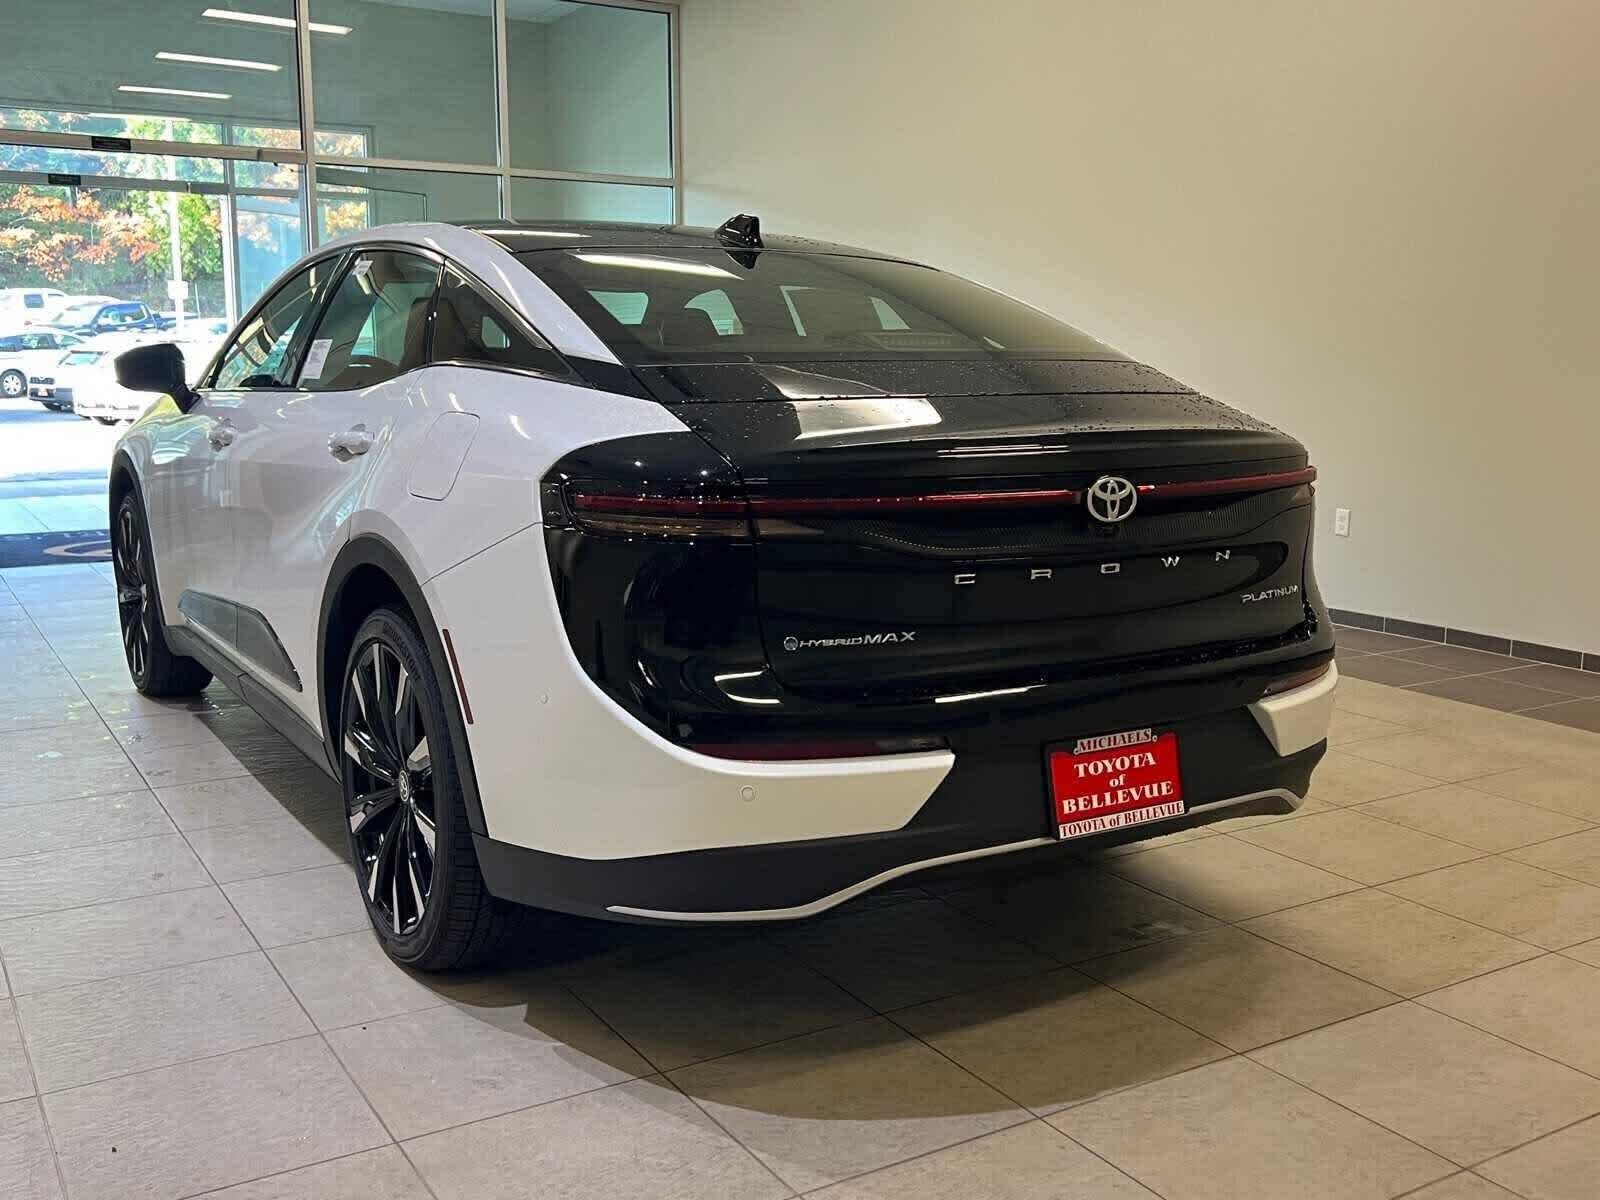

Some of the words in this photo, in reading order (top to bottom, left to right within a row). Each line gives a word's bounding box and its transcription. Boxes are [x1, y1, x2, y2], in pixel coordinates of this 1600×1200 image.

[954, 549, 1232, 586] CROWN
[1241, 584, 1299, 604] PLATINUM
[1073, 752, 1156, 778] TOYOTA
[1109, 774, 1127, 788] of
[1062, 781, 1174, 815] BELLEVUE
[1060, 818, 1106, 837] TOYOTA
[1109, 815, 1122, 827] of
[1124, 802, 1184, 823] BELLEVUE
